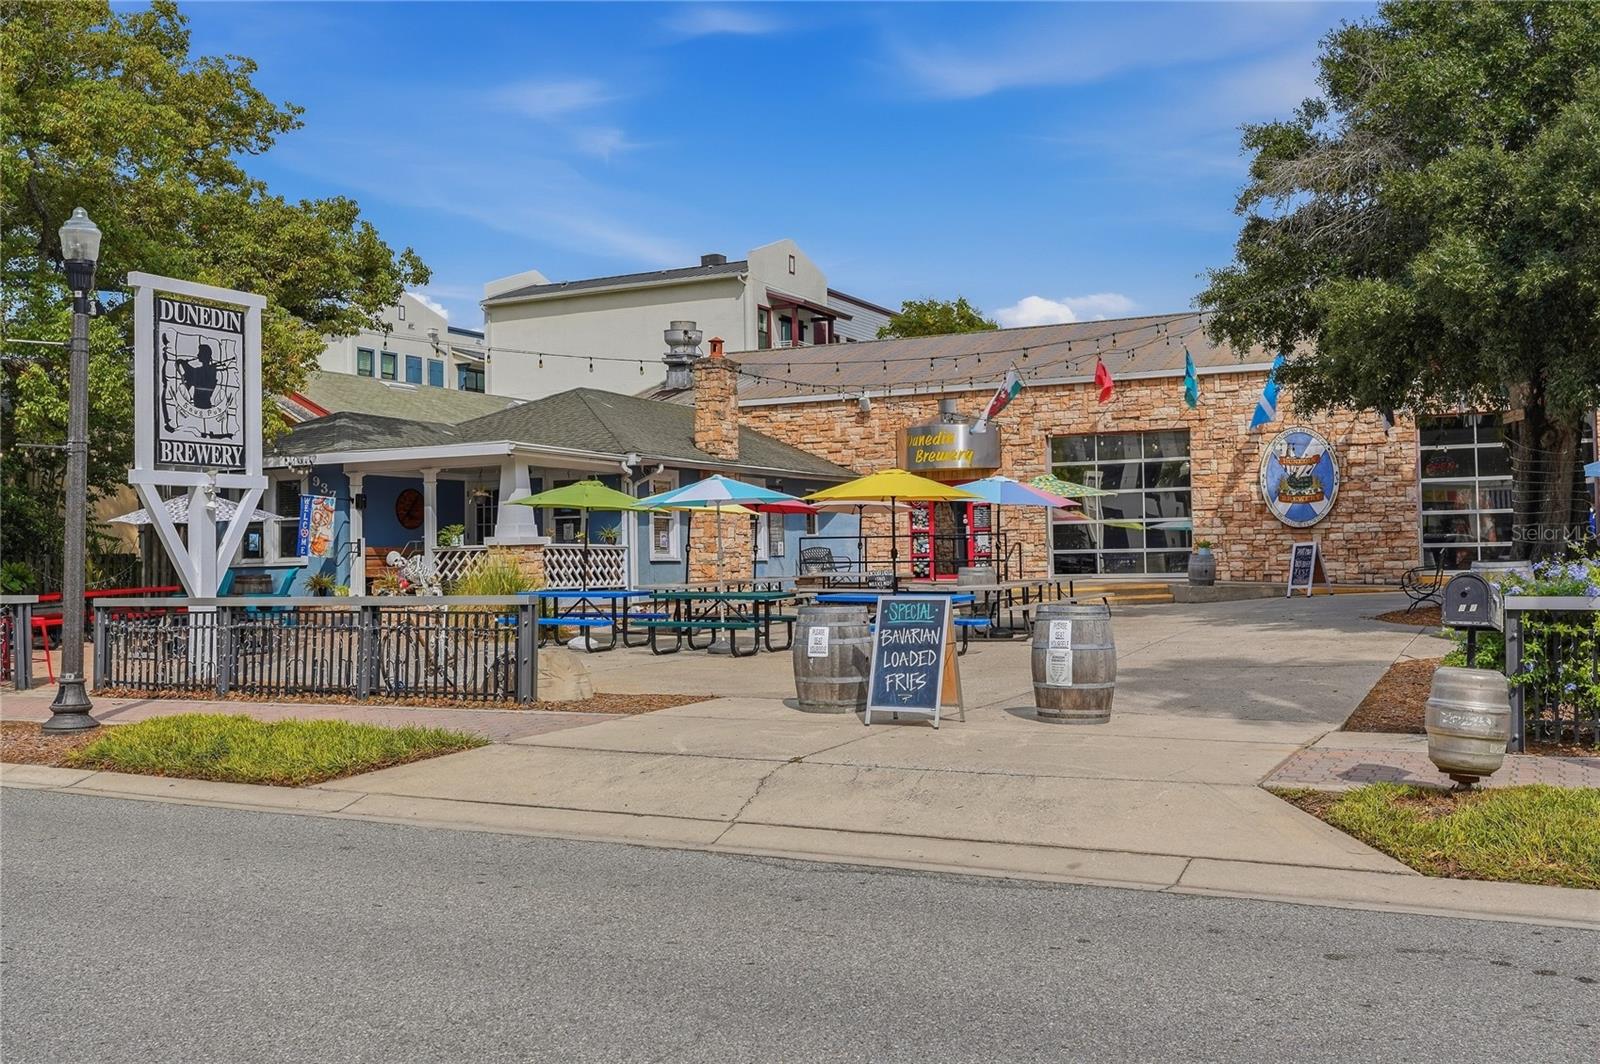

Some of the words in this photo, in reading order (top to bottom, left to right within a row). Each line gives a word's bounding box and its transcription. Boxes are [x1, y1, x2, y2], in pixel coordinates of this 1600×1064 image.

[160, 299, 241, 333] DUNEDIN
[160, 441, 244, 466] BREWERY
[301, 497, 312, 554] WELCOME
[888, 602, 936, 621] SPECIAL
[880, 626, 941, 647] BAVARIAN
[883, 649, 937, 668] LOADED
[884, 671, 928, 692] FRIES
